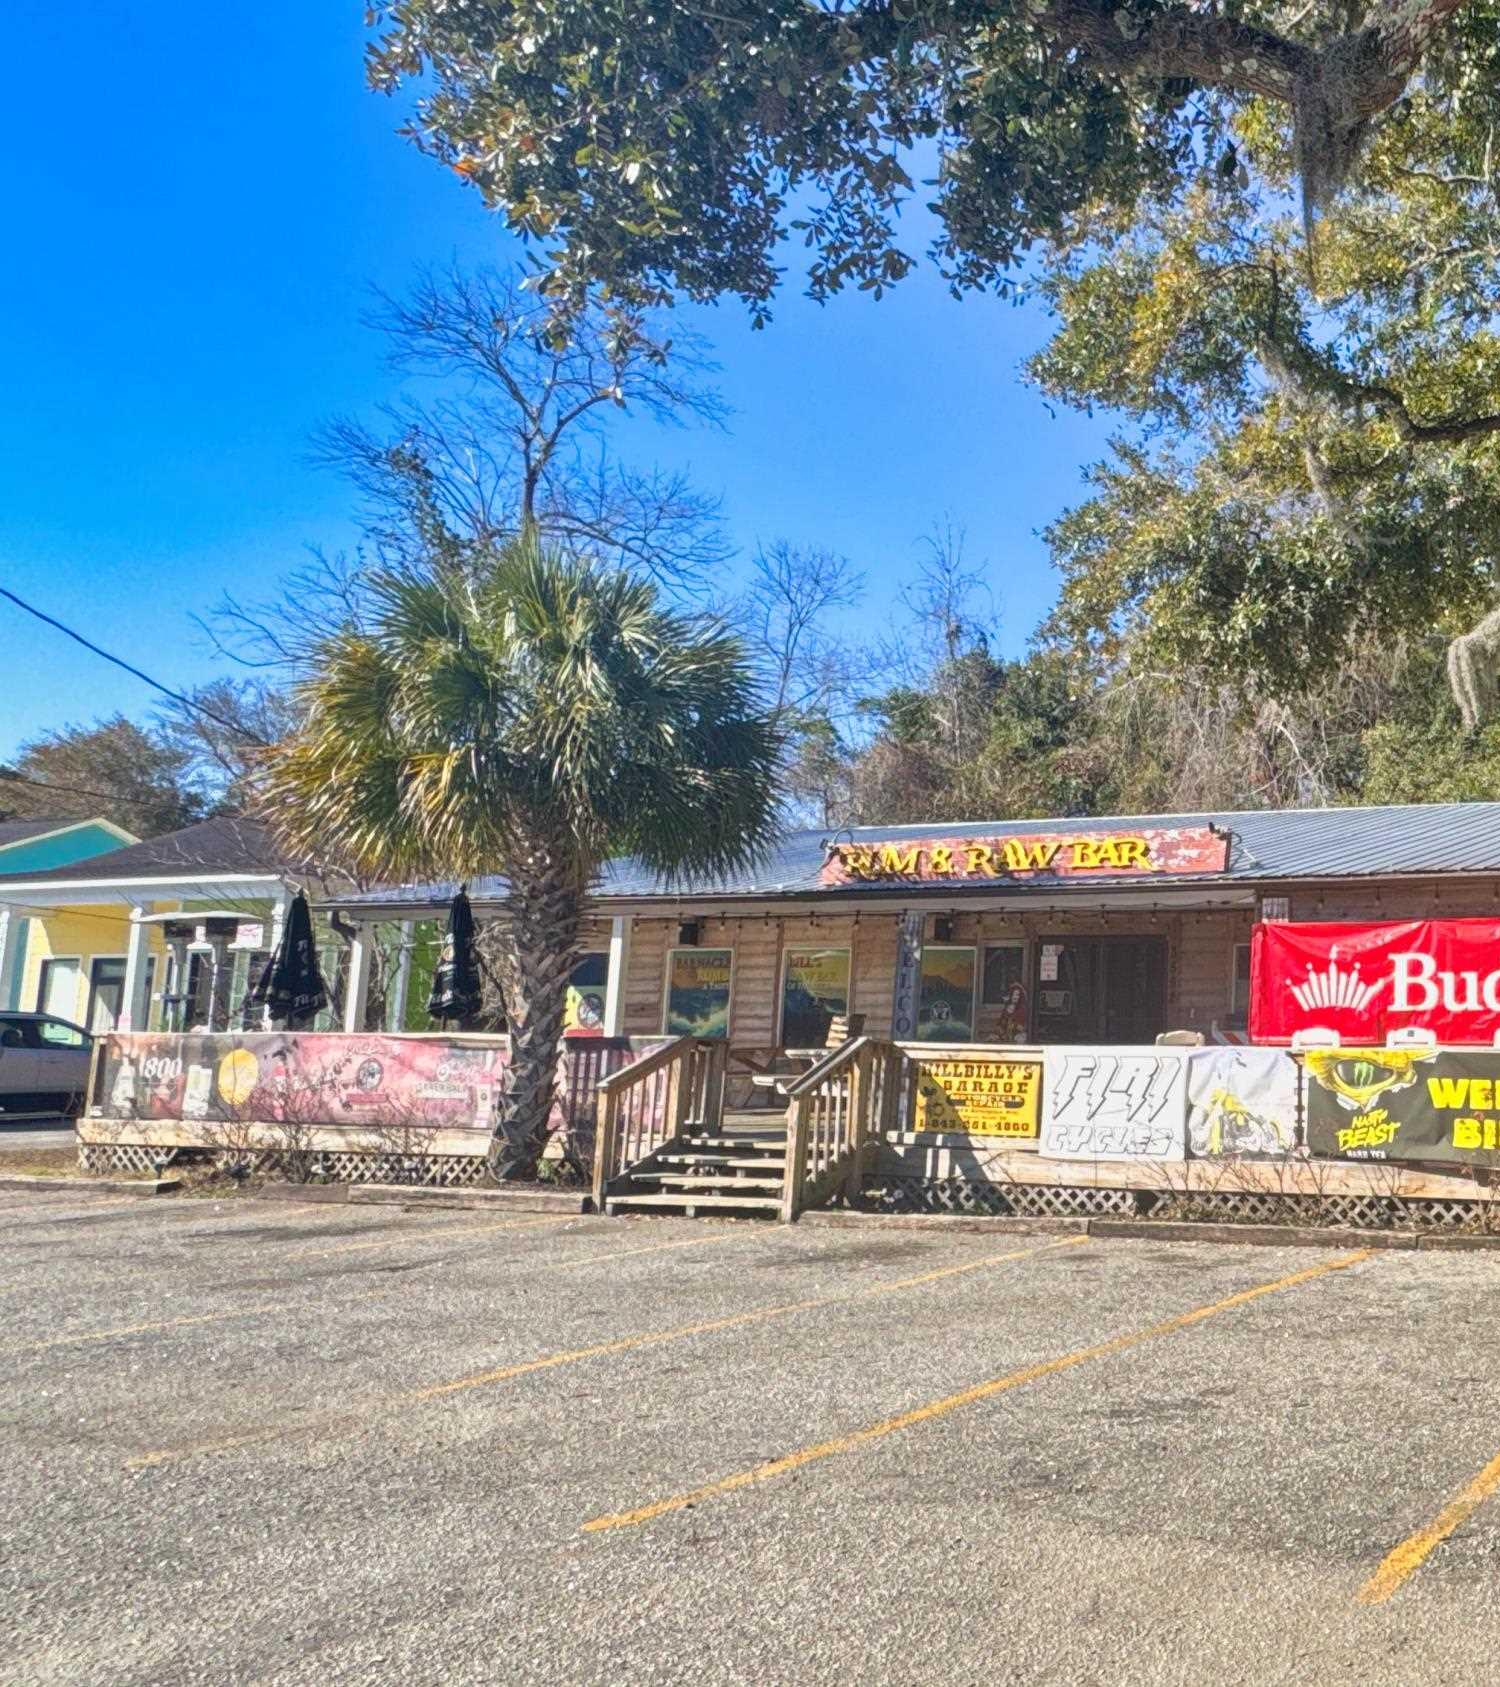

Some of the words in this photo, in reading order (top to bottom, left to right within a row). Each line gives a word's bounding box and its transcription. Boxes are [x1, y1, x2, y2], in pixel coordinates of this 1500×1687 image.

[840, 846, 920, 879] RM
[929, 847, 952, 873] &
[958, 838, 1058, 877] RAW
[1066, 836, 1155, 872] BAR
[919, 1063, 1033, 1080] HILLBILLY'S
[943, 1080, 1029, 1094] GARAGE
[1351, 1109, 1388, 1128] NASTY
[1047, 1125, 1174, 1155] CYCLES
[1337, 1121, 1401, 1151] BEAST
